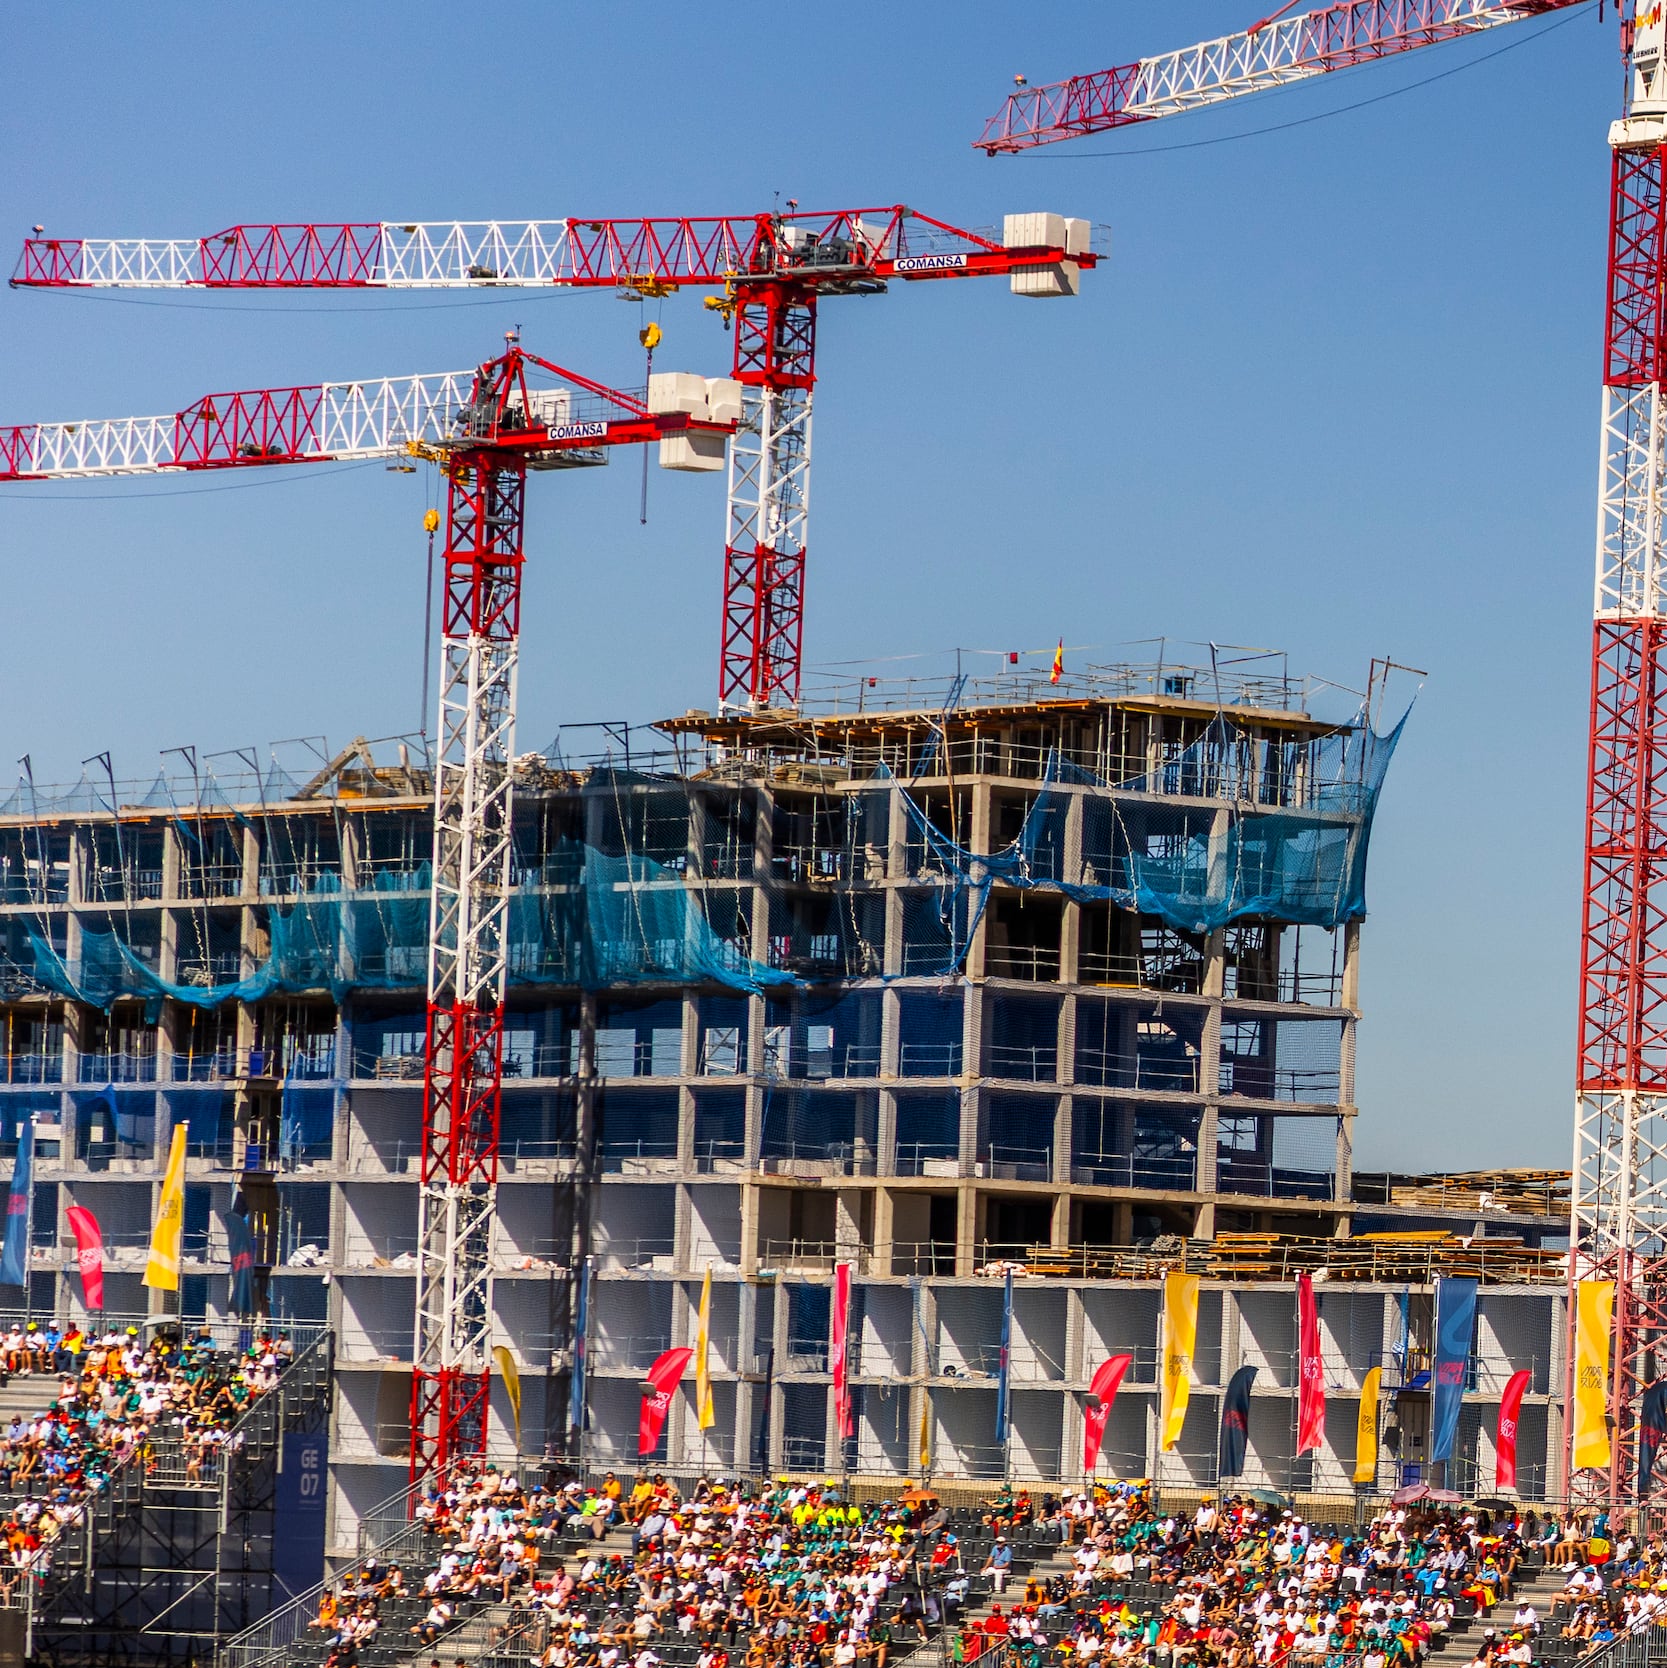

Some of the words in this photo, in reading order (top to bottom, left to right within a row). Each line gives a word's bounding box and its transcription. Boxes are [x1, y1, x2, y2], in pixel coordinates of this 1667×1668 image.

[897, 255, 963, 270] COMANSA
[550, 423, 603, 439] COMANSA
[301, 1449, 318, 1468] GE
[300, 1473, 319, 1496] 07
